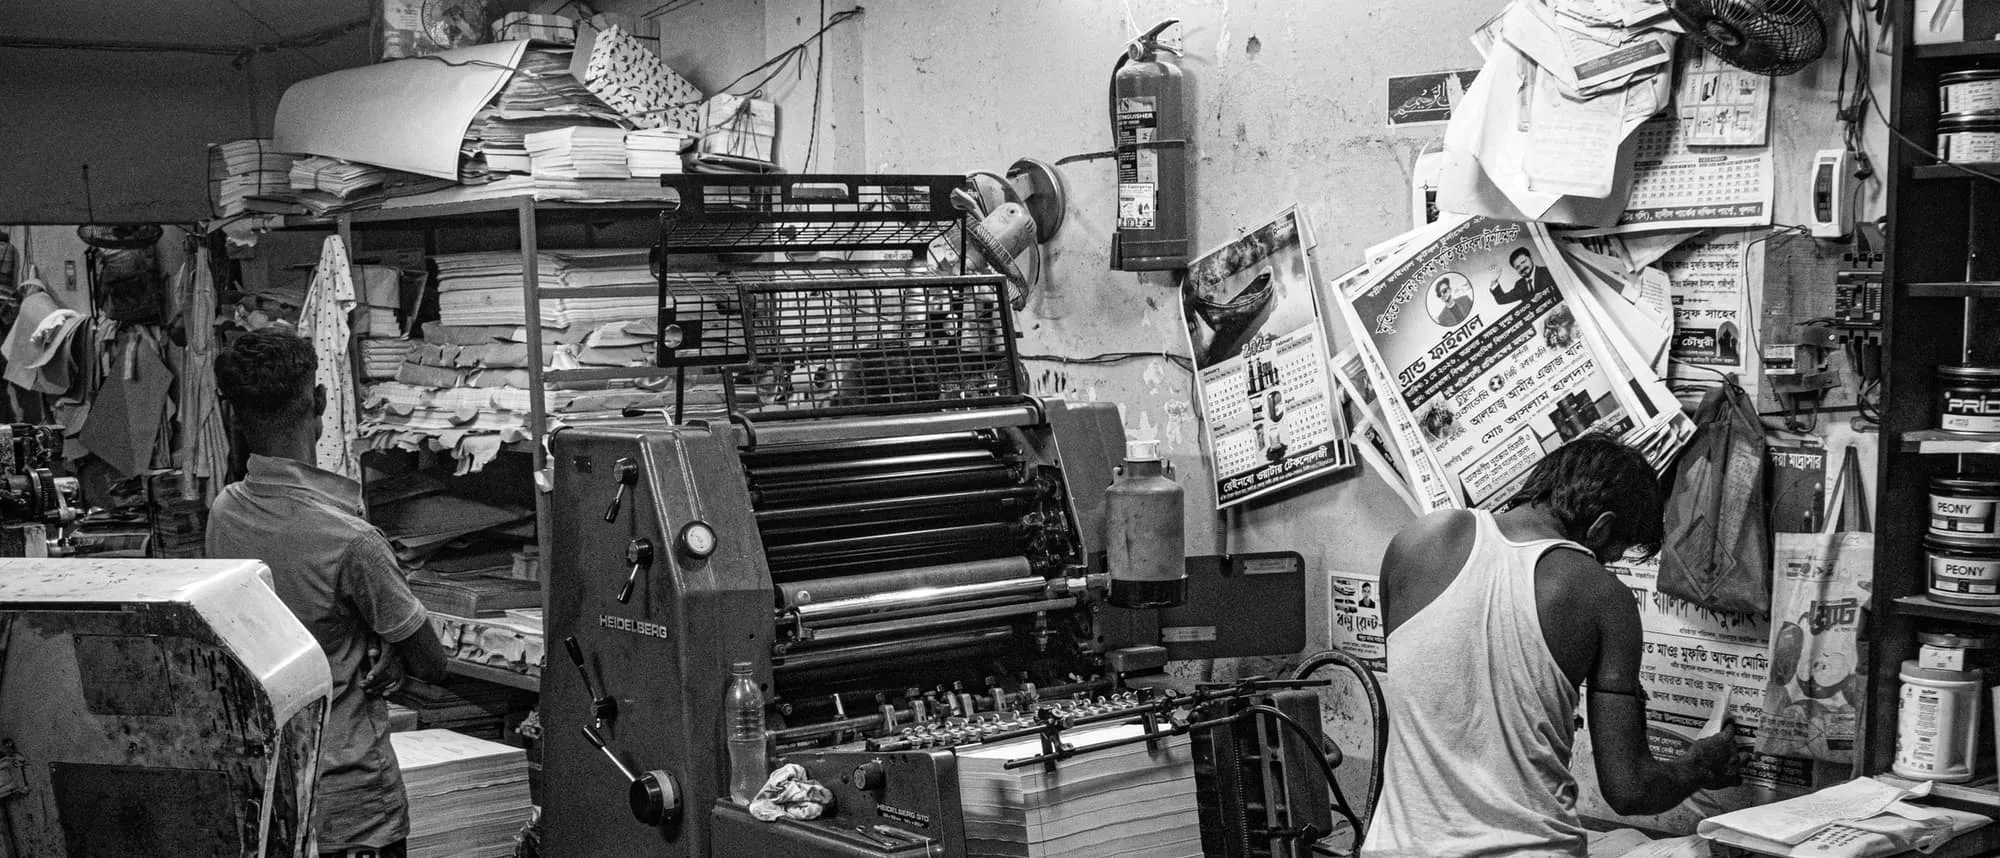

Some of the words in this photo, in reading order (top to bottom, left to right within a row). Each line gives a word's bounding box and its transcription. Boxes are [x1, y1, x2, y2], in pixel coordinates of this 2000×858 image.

[1241, 335, 1273, 359] 2025
[1429, 315, 1481, 359] ফাইনাল
[1565, 341, 1583, 358] খান
[1481, 425, 1503, 444] মোঃ
[1506, 391, 1548, 425] আসলাম
[1554, 360, 1593, 392] হালদার
[1222, 472, 1254, 492] রেইনবো
[1255, 462, 1283, 480] ওয়াটার
[1937, 502, 1972, 514] PEONY
[1945, 564, 1985, 577] PEONY
[599, 614, 668, 640] HEIDELBERG
[1657, 644, 1678, 658] মাওঃ
[1680, 645, 1708, 663] মুফতি
[1710, 651, 1739, 668] আব্দুল
